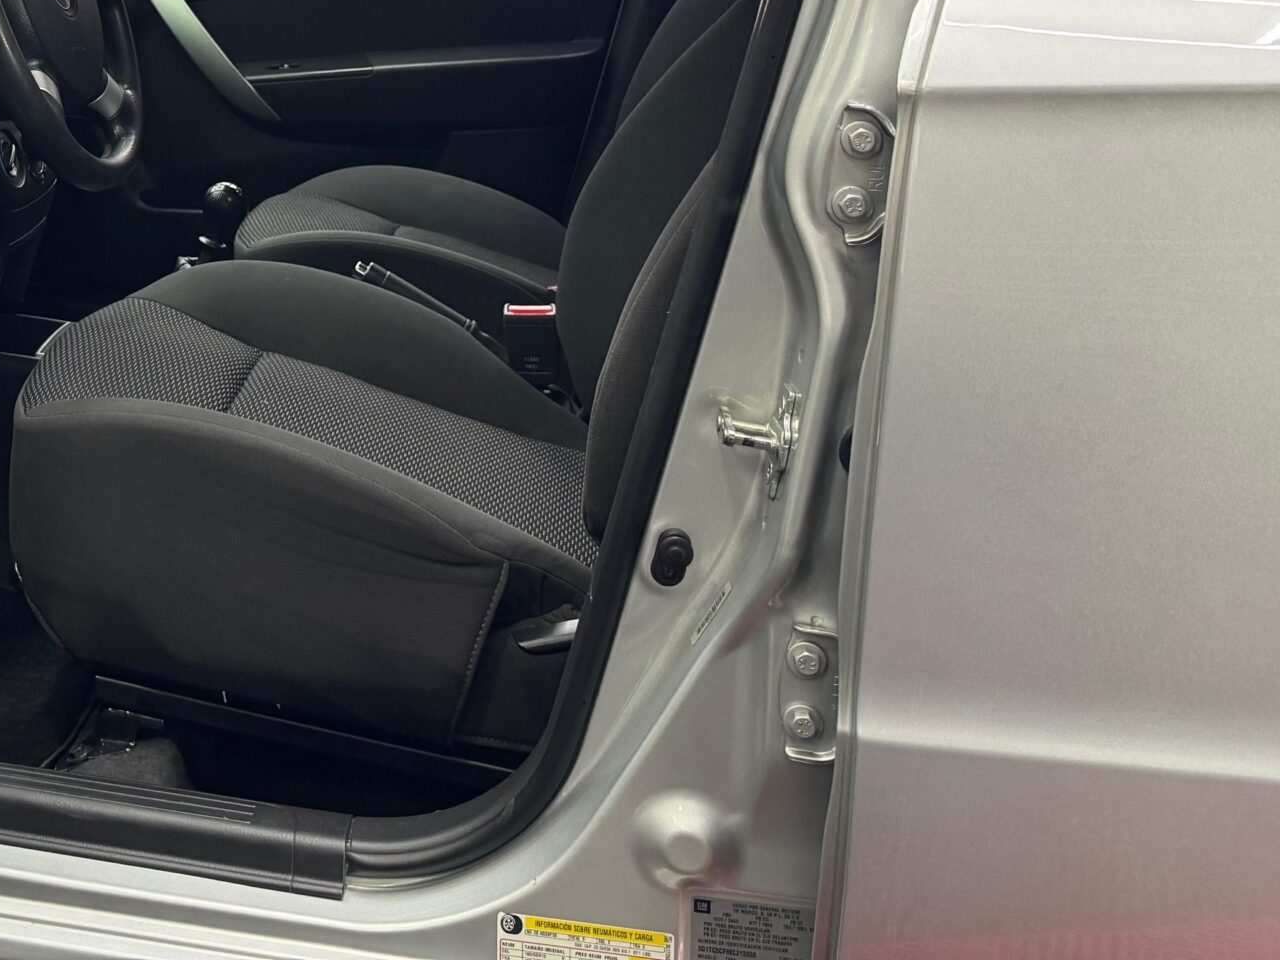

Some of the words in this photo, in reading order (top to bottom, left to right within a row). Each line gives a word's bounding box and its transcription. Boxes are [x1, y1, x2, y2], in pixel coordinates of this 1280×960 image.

[534, 919, 572, 932] INFORMACIÓN
[573, 924, 591, 934] SOBRE
[592, 926, 628, 939] NEUMÁTICOS
[635, 933, 654, 942] CARGA
